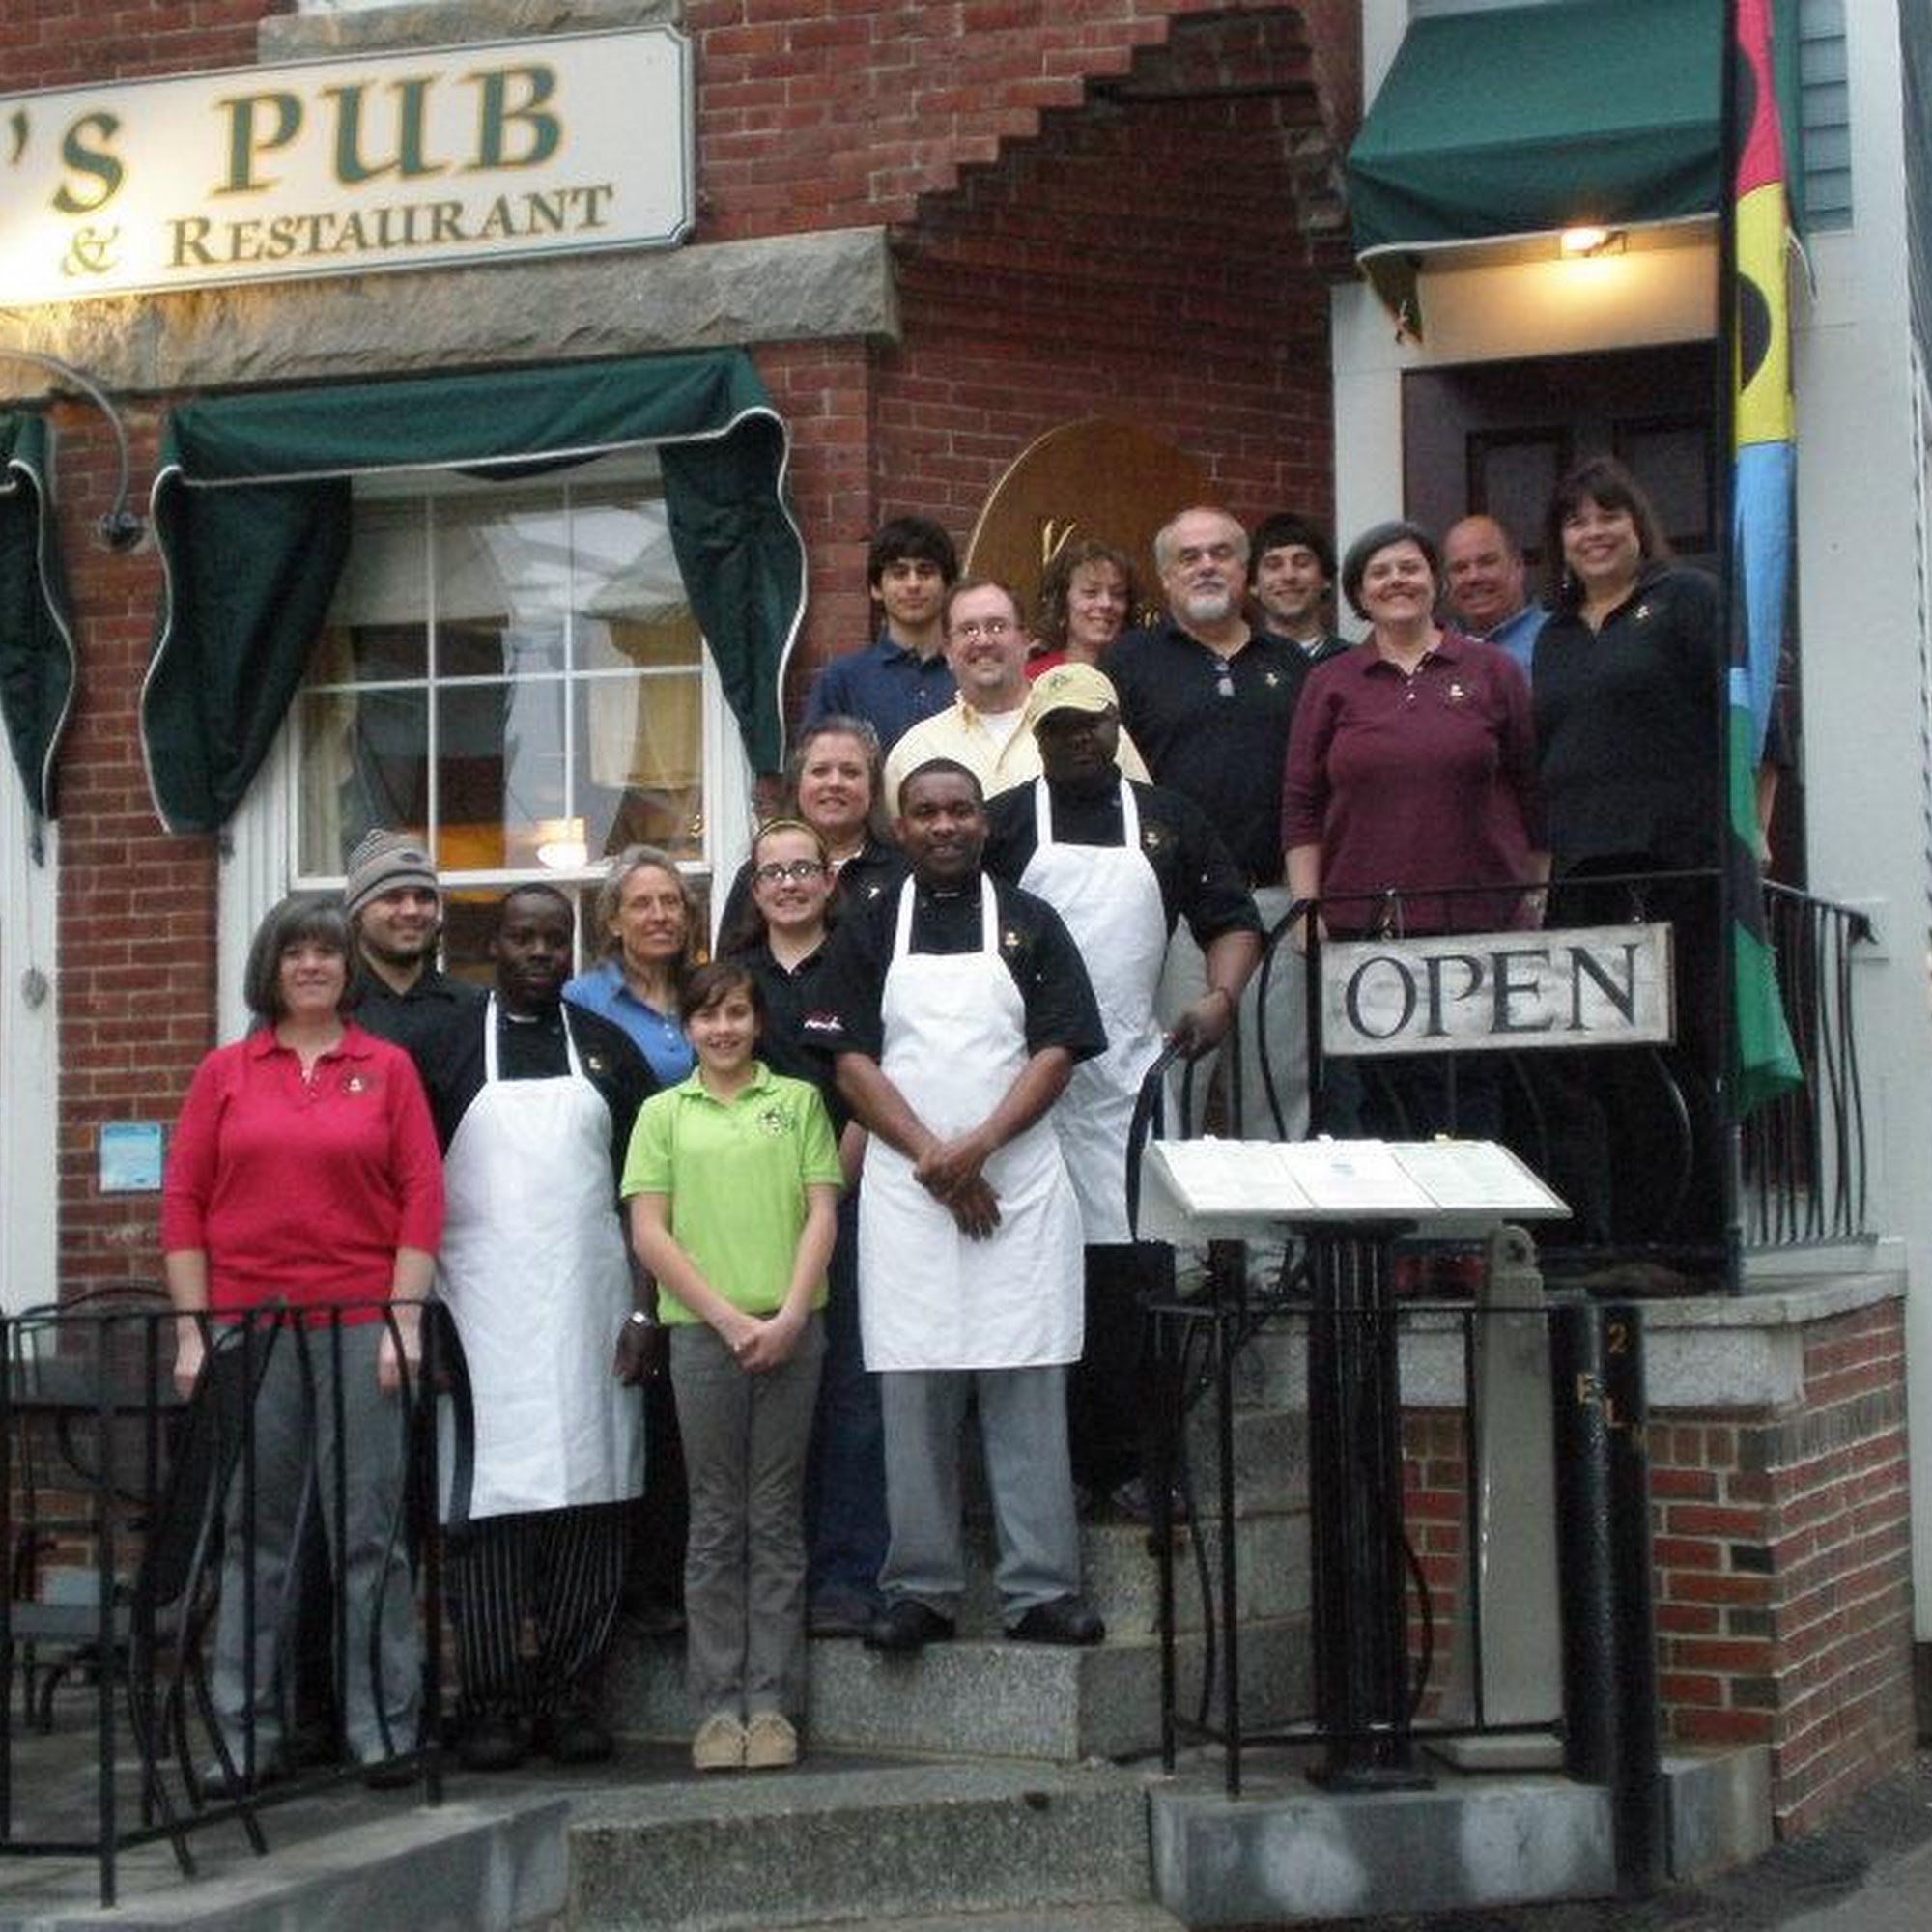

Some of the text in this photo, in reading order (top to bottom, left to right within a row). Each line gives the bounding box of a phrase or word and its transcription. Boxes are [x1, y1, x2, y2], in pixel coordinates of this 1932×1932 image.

[208, 62, 566, 196] PUB
[61, 225, 120, 278] &
[1346, 943, 1639, 1040] OPEN
